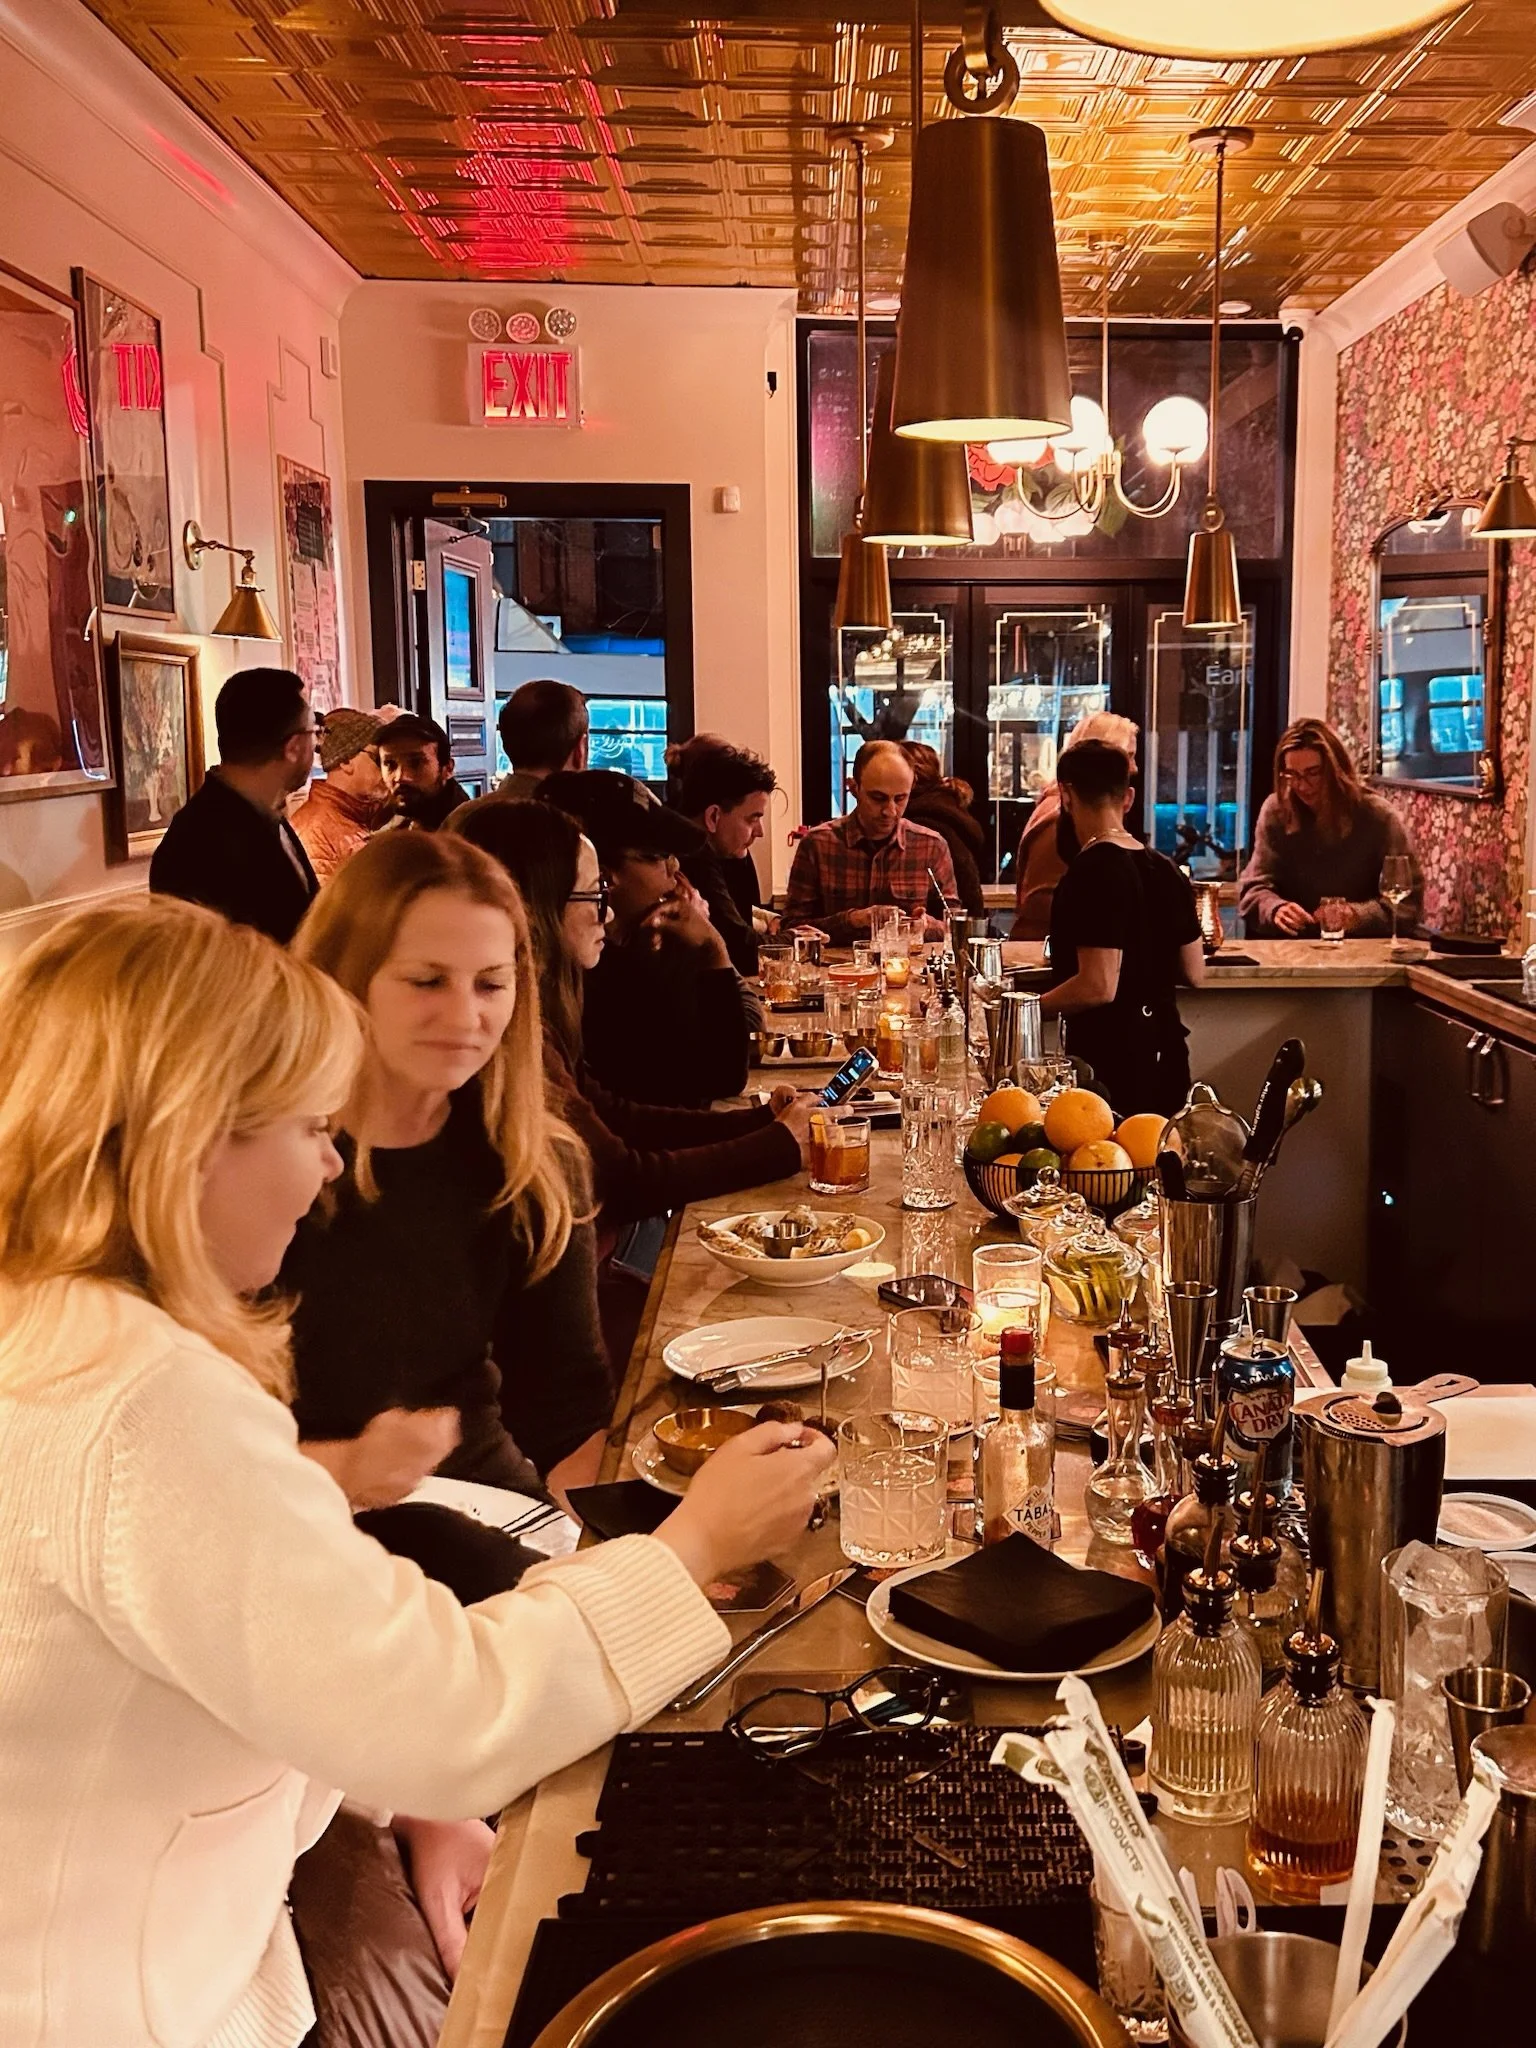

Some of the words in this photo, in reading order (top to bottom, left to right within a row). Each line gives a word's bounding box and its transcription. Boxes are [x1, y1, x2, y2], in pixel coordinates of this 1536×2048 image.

[483, 351, 572, 418] EXIT
[1229, 1393, 1292, 1424] CANAD
[1252, 1408, 1285, 1433] DRY
